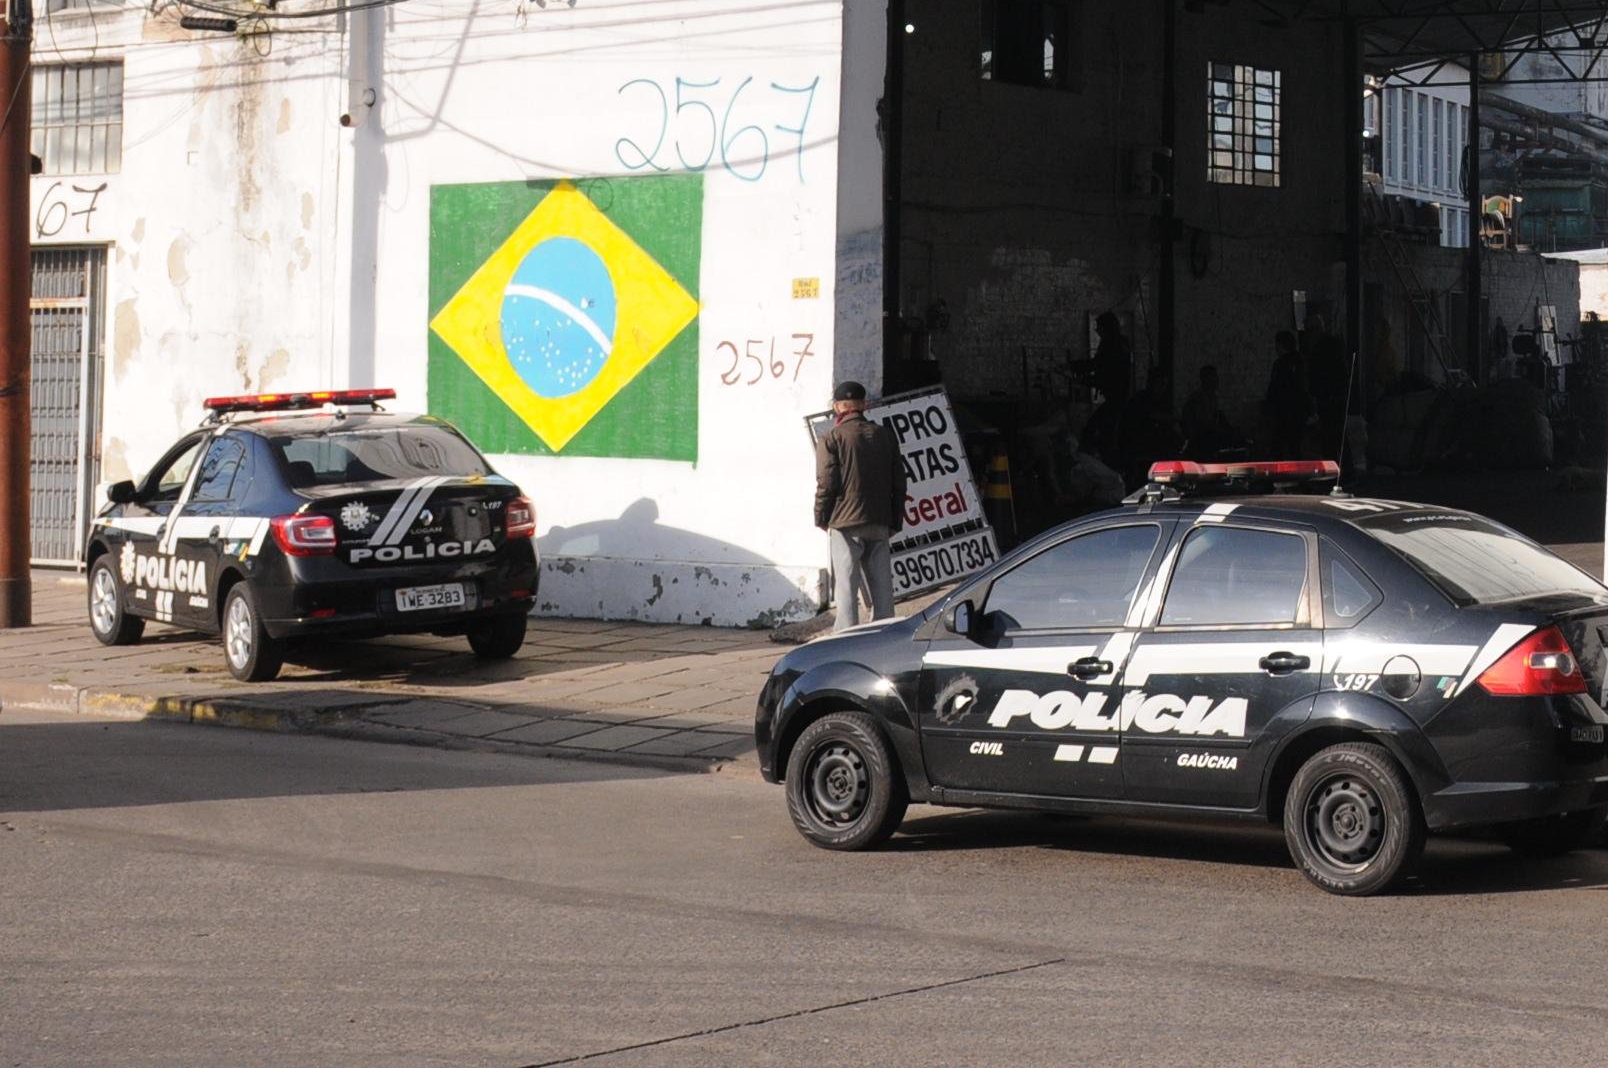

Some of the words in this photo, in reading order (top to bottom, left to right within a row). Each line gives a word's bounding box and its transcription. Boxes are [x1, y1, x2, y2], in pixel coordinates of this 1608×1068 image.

[614, 75, 821, 185] 2567
[35, 181, 108, 240] 67
[715, 332, 816, 388] 2567
[882, 405, 948, 444] PRO
[901, 443, 960, 484] ATAS
[903, 482, 968, 527] Geral
[1342, 673, 1381, 692] 197
[969, 740, 1004, 756] CIVIL
[1177, 751, 1238, 770] GAÚCHA
